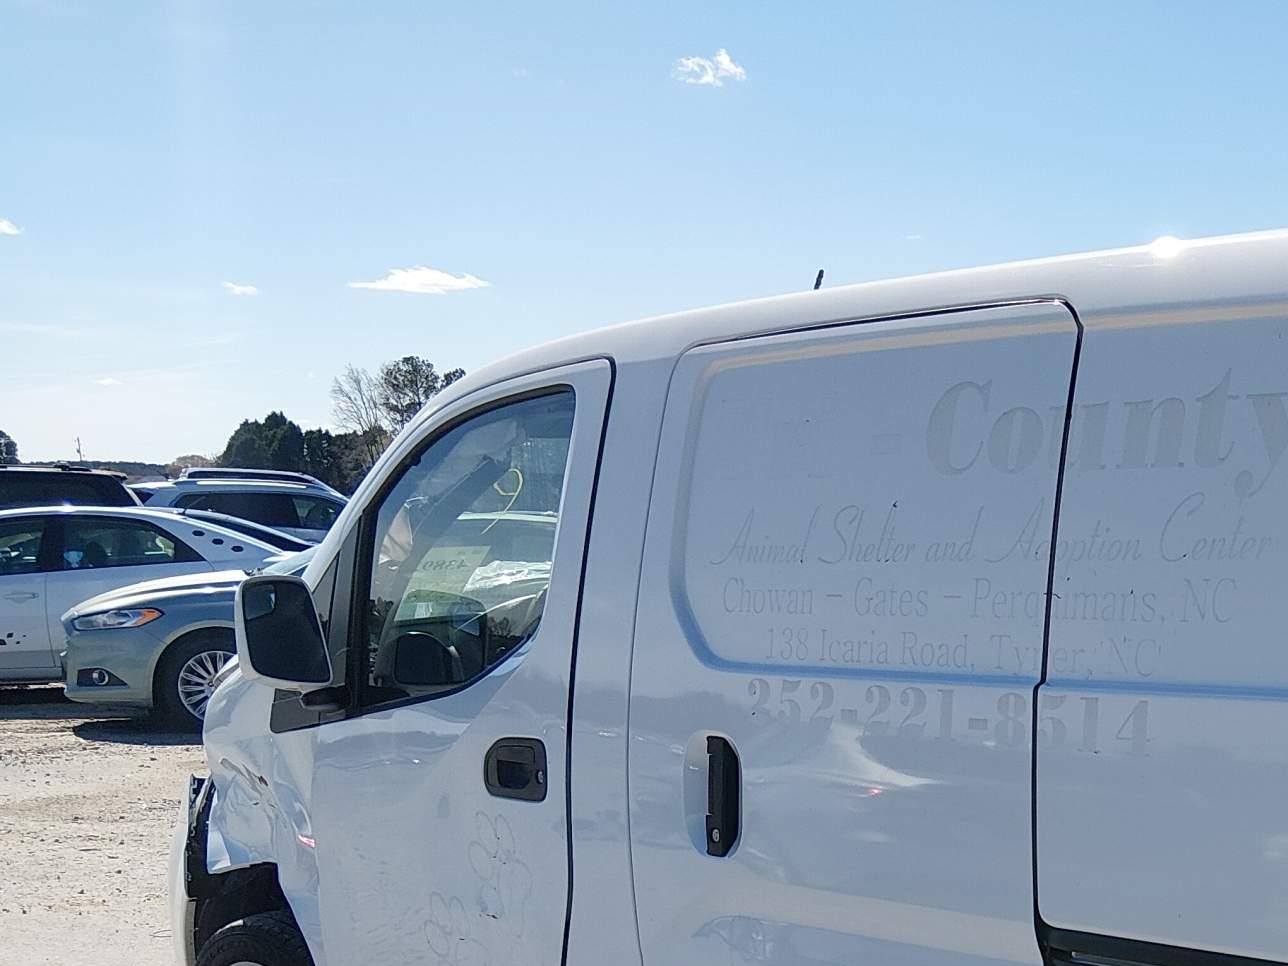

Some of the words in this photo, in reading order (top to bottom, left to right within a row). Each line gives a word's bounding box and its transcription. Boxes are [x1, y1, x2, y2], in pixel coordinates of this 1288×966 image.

[709, 505, 821, 566] Animal
[817, 500, 917, 565] Shelter
[925, 506, 985, 563] and
[1160, 491, 1274, 564] Center
[722, 577, 813, 616] Chowan
[853, 576, 928, 618] Gates
[1180, 577, 1239, 625] NC
[765, 627, 809, 662] 138
[819, 628, 889, 666] Icaria
[899, 631, 976, 673] Road,
[1104, 637, 1157, 677] NC
[747, 678, 1152, 757] 352-221-8514
